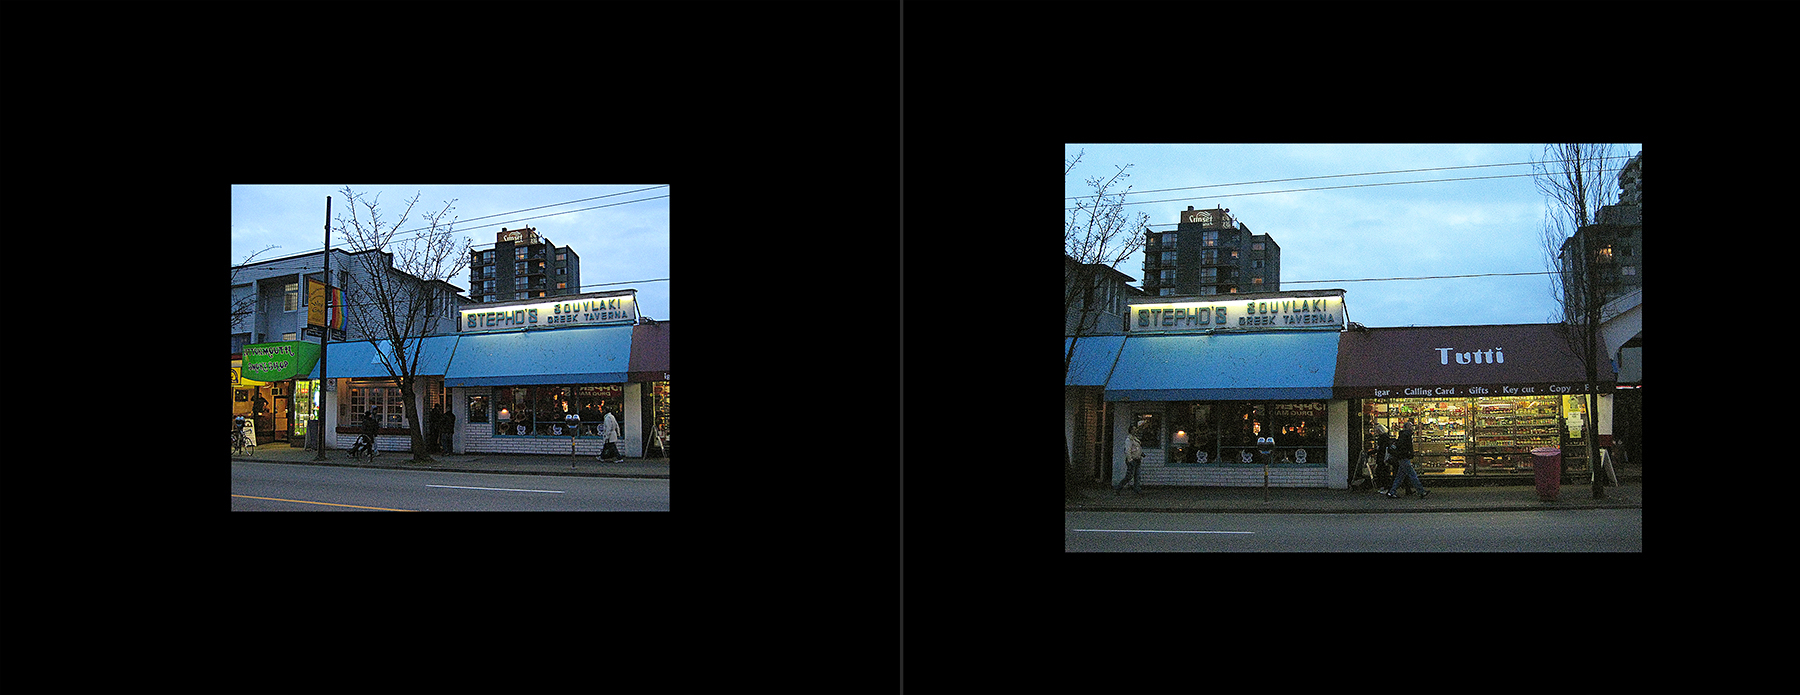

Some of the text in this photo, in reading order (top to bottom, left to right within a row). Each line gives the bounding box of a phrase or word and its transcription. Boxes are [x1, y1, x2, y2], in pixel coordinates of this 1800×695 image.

[553, 299, 621, 314] SOUVLAKI
[1247, 299, 1327, 314] SOUVLAKI
[467, 308, 538, 328] STEPHO'S
[547, 310, 629, 324] GREEK TAVERNA
[1138, 306, 1227, 327] STEPHO'S
[1238, 313, 1334, 326] GREEK TAVERNA
[1435, 347, 1504, 365] Tutti
[1404, 387, 1432, 396] Calling
[1435, 387, 1455, 395] Card
[1468, 386, 1489, 394] Gifts
[1502, 385, 1519, 394] Key
[1549, 384, 1571, 393] Copy
